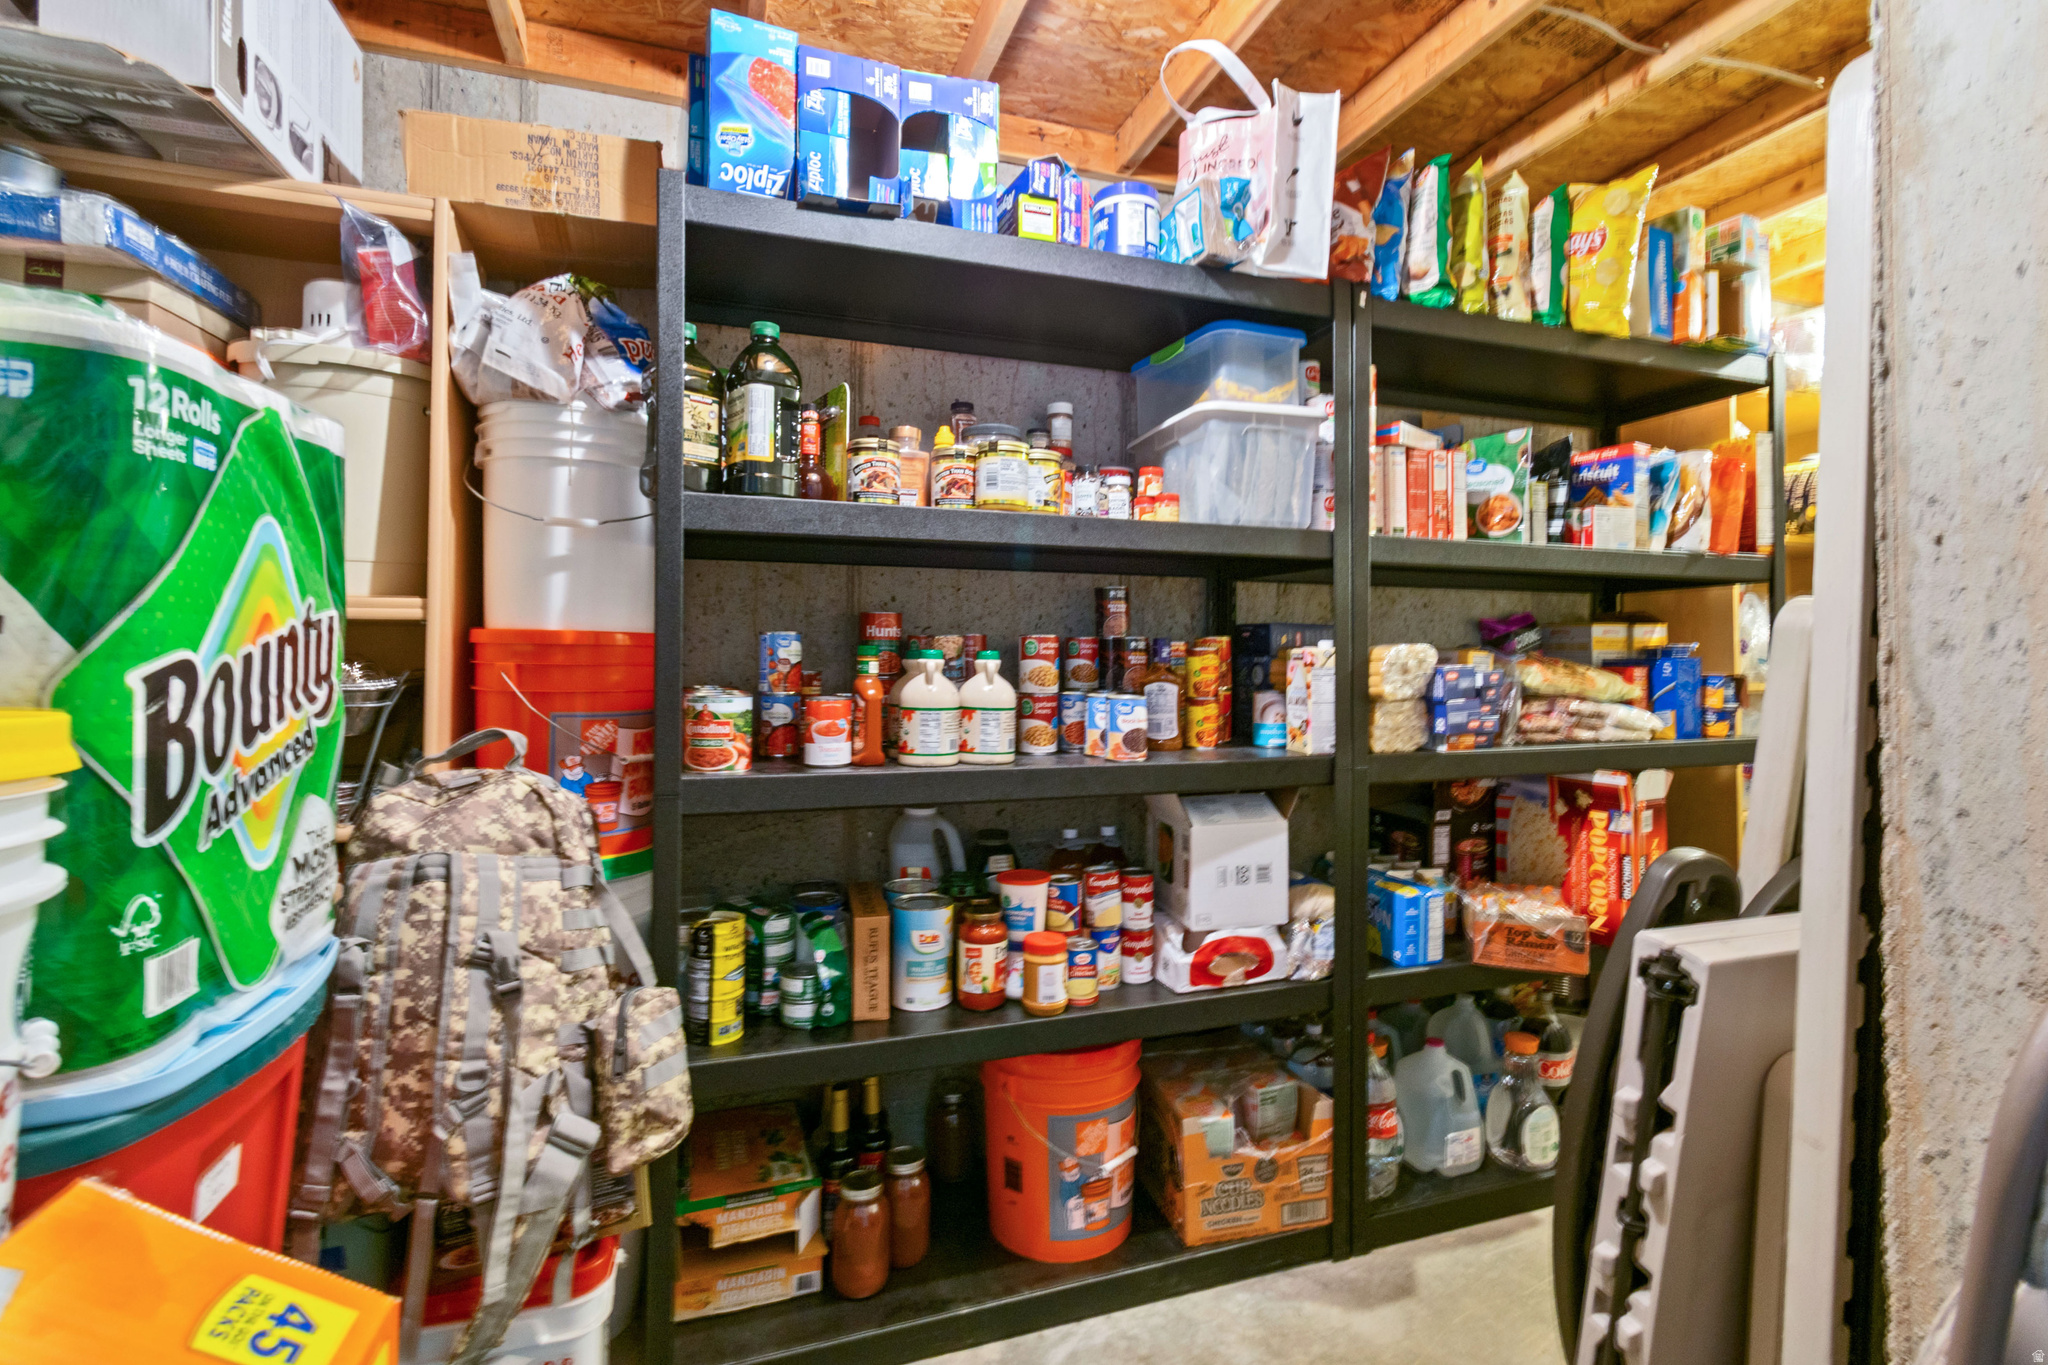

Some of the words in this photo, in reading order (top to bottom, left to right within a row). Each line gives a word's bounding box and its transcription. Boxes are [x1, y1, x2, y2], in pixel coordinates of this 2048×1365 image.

[562, 139, 571, 148] IN
[566, 149, 599, 161] CARTON
[575, 141, 599, 152] MADE
[720, 162, 790, 197] Ziploc
[807, 152, 822, 193] Ziploc
[27, 265, 62, 278] Clarks
[128, 375, 170, 414] 12
[171, 386, 221, 435] Rolls
[132, 421, 190, 447] Longer
[132, 438, 188, 464] Sheets
[1600, 449, 1619, 460] size
[134, 602, 338, 842] Bounty
[199, 718, 315, 851] Advanced
[1587, 809, 1609, 935] POPCORN
[1608, 847, 1617, 900] MICROWAVE
[1622, 855, 1632, 900] KIRKLAND
[869, 927, 879, 960] RUFUS
[1504, 927, 1532, 941] Top
[1505, 936, 1558, 951] Ramen
[869, 967, 879, 1012] TEAGUE
[1219, 1180, 1251, 1194] CUP
[716, 1201, 786, 1225] MANDARIN
[1202, 1191, 1264, 1217] NOODLES
[716, 1268, 786, 1291] MANDARIN
[209, 1286, 262, 1342] PACKS
[249, 1304, 317, 1364] 45
